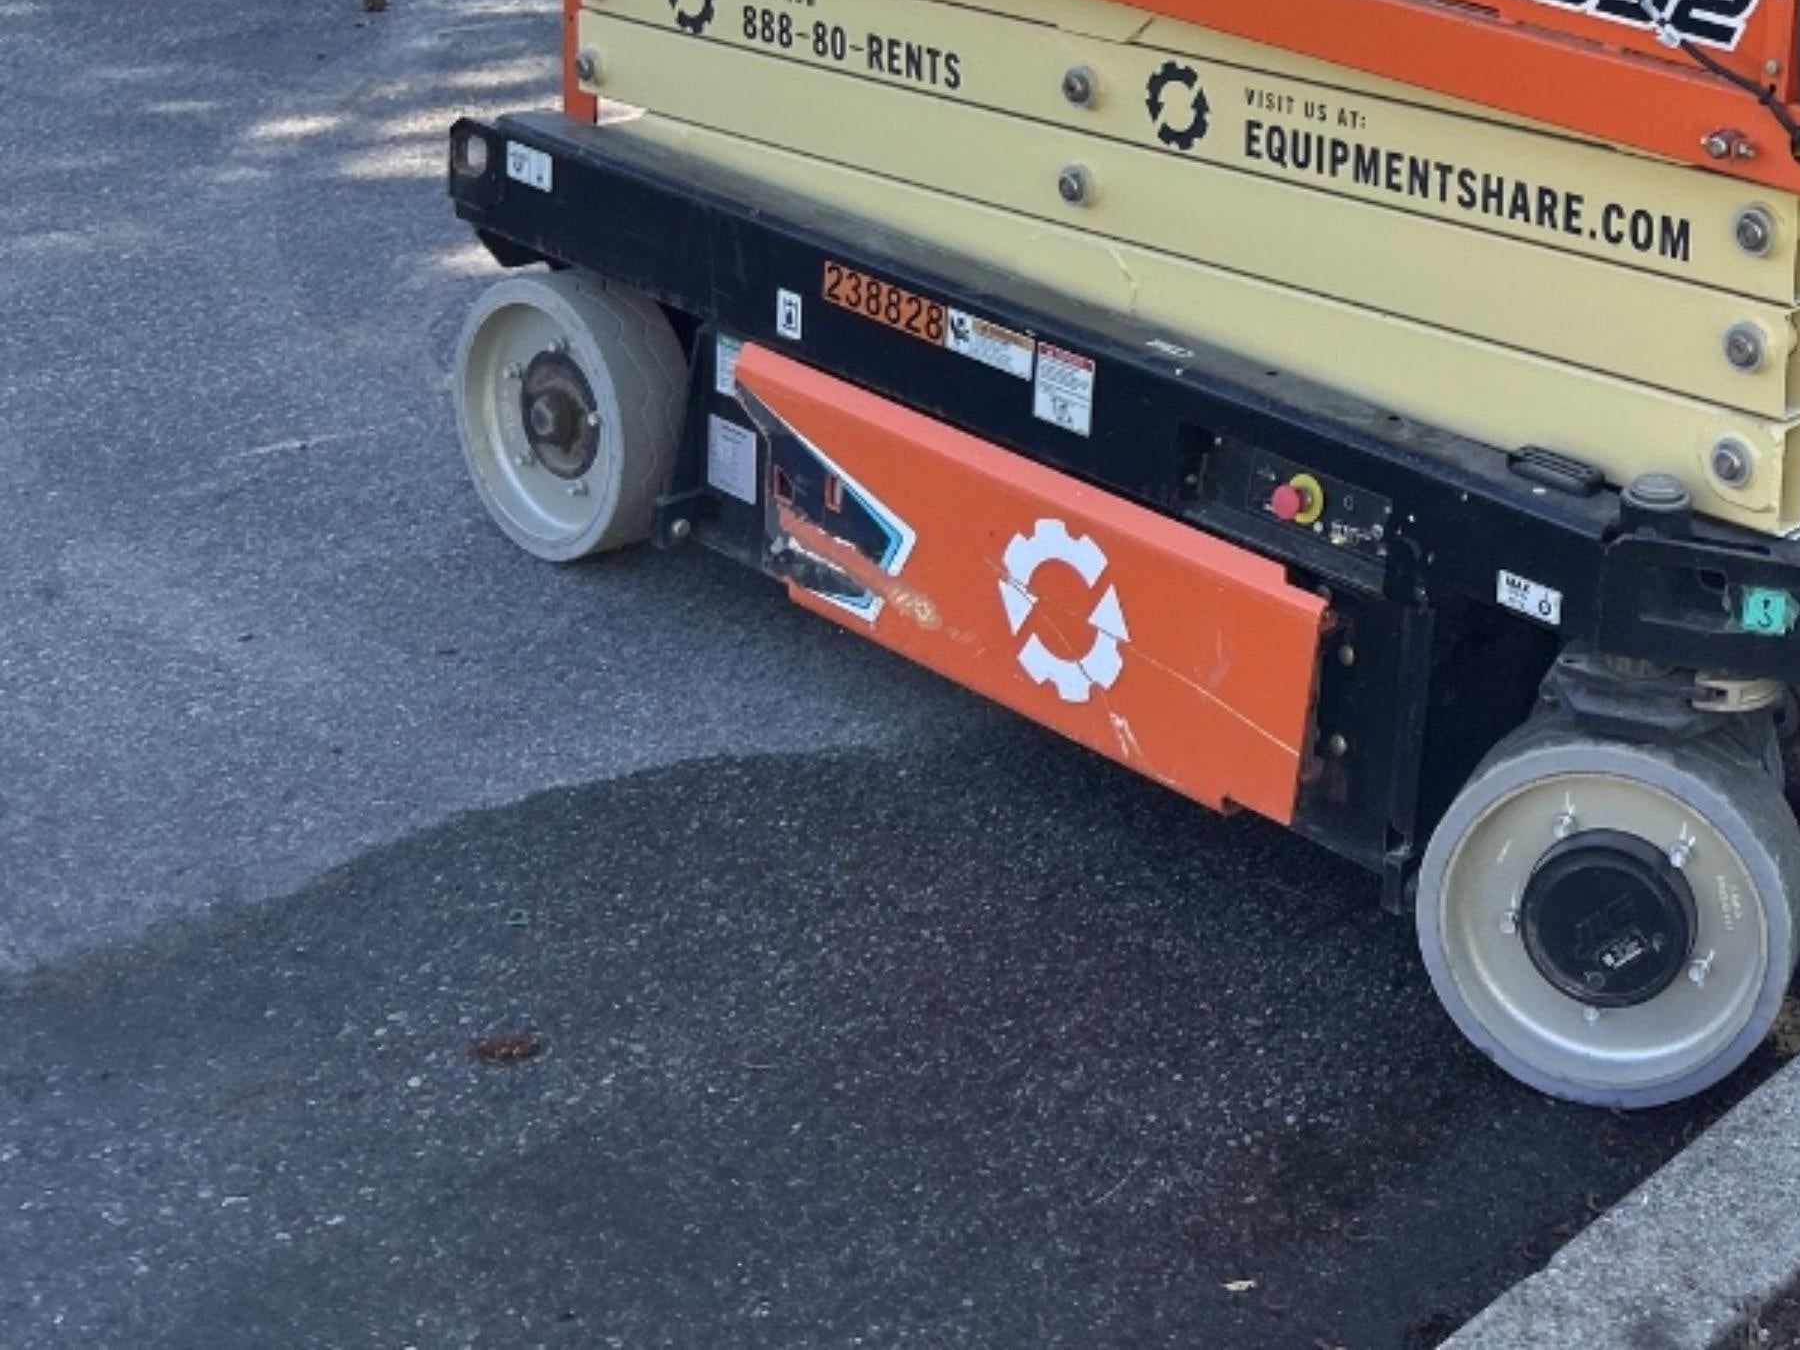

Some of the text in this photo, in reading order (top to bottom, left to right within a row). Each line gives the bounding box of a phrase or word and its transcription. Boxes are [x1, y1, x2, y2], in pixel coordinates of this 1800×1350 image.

[741, 4, 963, 91] 888-80-RENTS
[1244, 85, 1367, 131] VISIT US AT:
[1243, 119, 1692, 264] EQUIPMENTSHARE.COM
[825, 265, 944, 341] 238828
